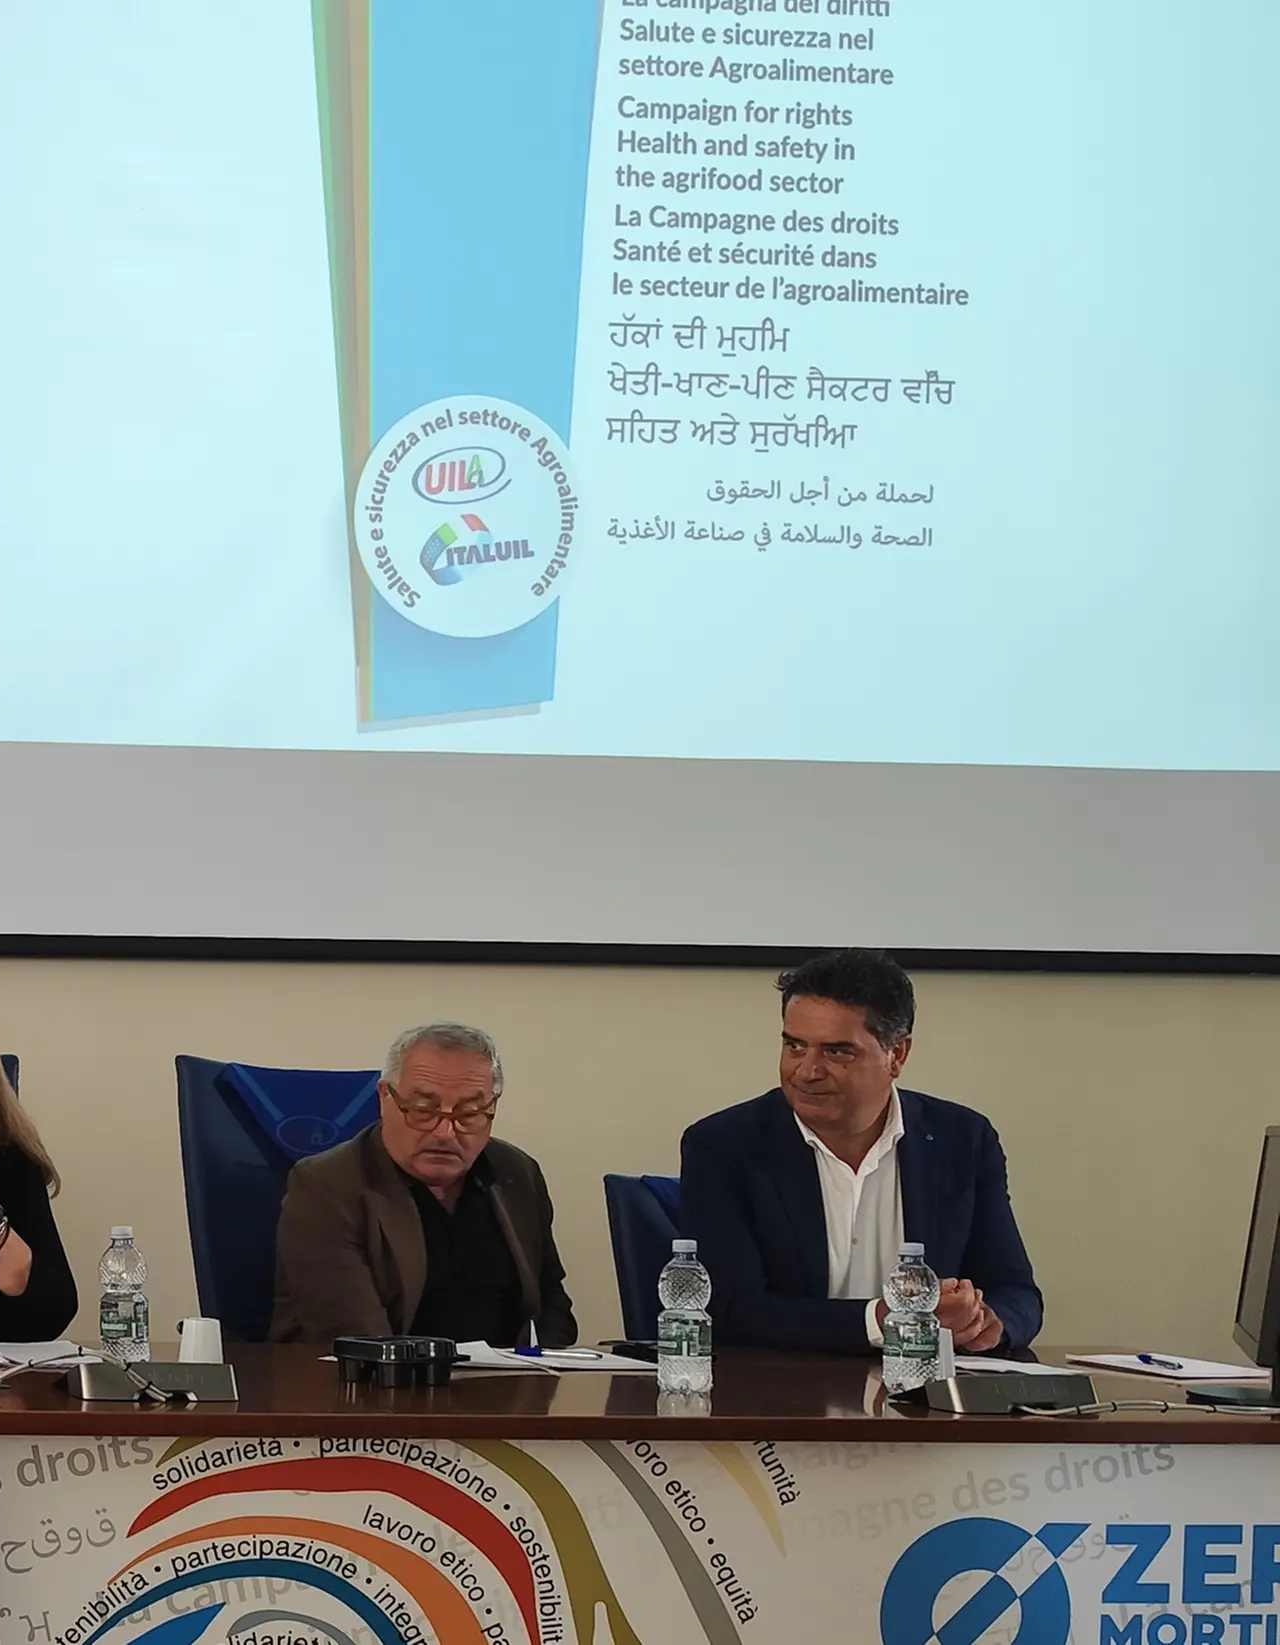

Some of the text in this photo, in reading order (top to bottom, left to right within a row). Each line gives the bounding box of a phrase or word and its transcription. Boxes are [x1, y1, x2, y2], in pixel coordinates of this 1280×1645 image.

[619, 18, 874, 51] Salute e sicurezza nel
[618, 55, 894, 85] settore Agroalimentare
[617, 95, 853, 129] Campaign for rights
[617, 130, 856, 164] Health and safety in
[615, 164, 845, 195] the agrifood sector
[614, 203, 899, 236] La Campagne des droits
[612, 238, 877, 270] Santé et sécurité dans
[612, 271, 633, 296] le
[639, 276, 730, 299] secteur
[735, 276, 766, 300] de
[424, 453, 485, 496] UILA
[365, 408, 578, 608] Salute e sicurezza nel settore Agroalimentare
[706, 479, 781, 505] الحقوق
[837, 487, 868, 507] من
[683, 519, 746, 542] صناعة
[753, 521, 773, 552] في
[780, 522, 863, 549] والسلامة
[870, 525, 933, 547] الصحة
[951, 1470, 1031, 1514] des
[170, 1535, 358, 1580] partecipazione
[362, 1504, 437, 1553] lavoro
[439, 1550, 485, 1602] etico
[664, 1479, 707, 1533] etico
[709, 1552, 759, 1625] equità
